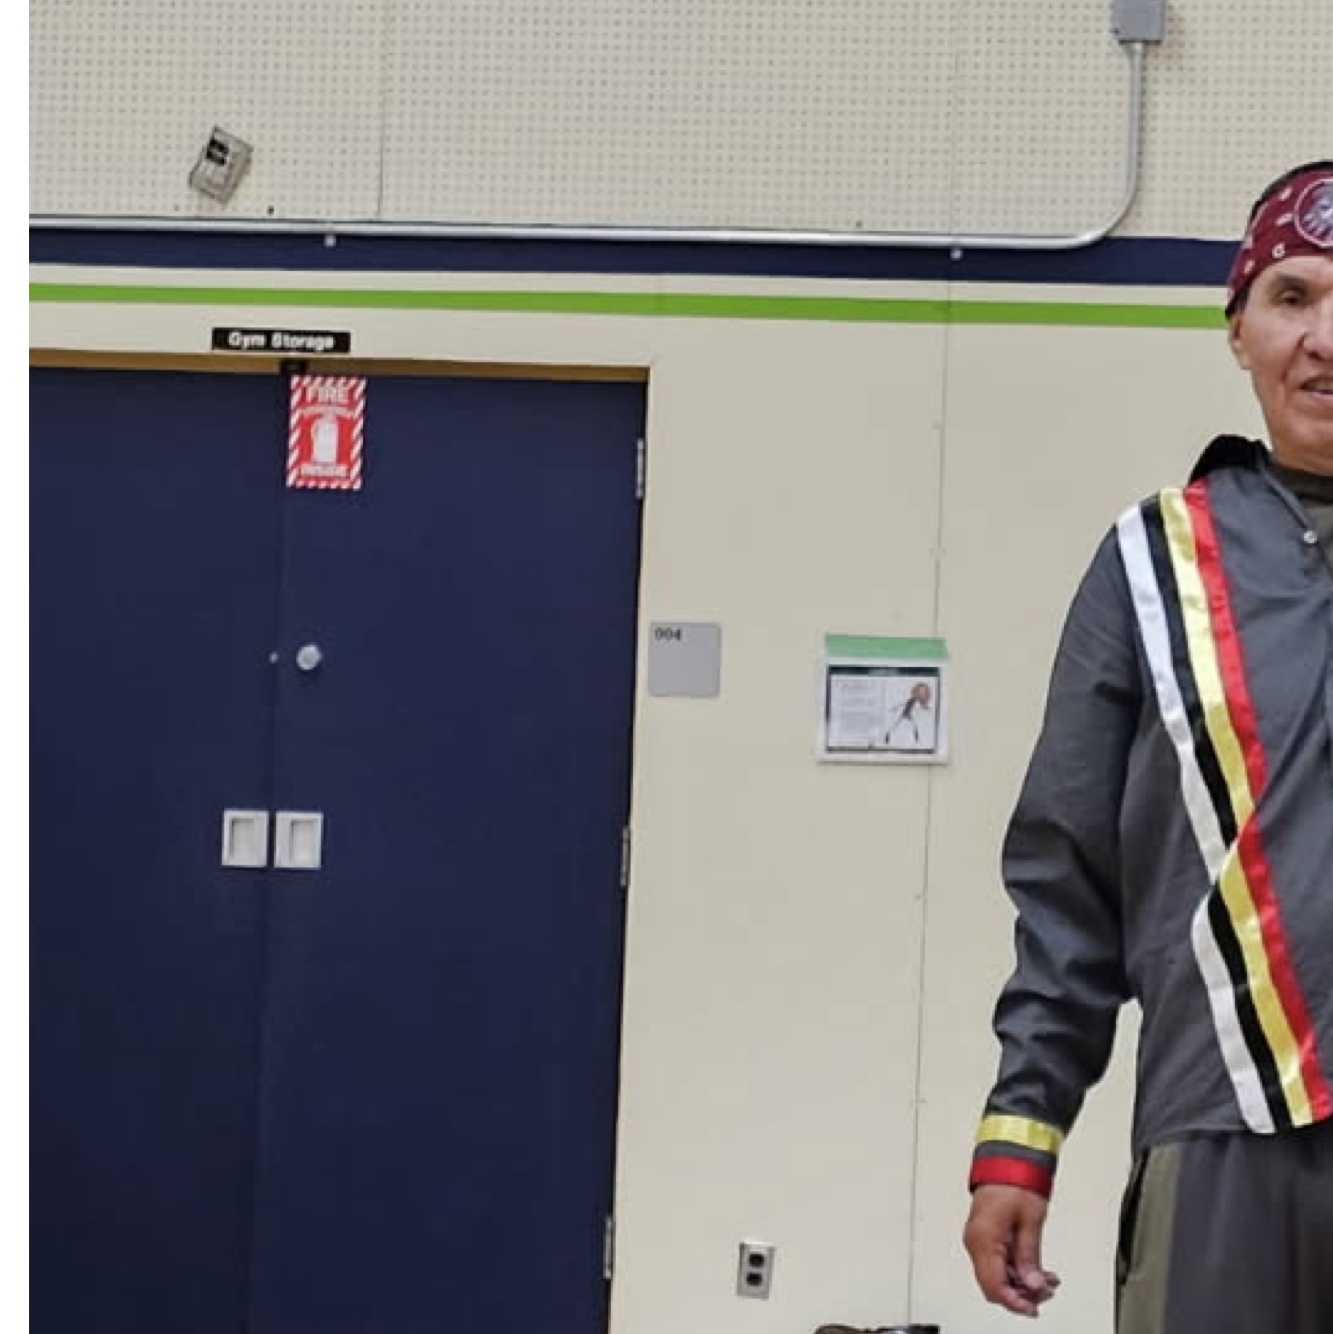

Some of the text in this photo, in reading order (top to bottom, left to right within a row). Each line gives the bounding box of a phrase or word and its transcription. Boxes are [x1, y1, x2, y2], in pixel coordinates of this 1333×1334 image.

[228, 331, 336, 352] Gym Storage
[305, 386, 349, 404] FIRE
[654, 626, 682, 642] 004
